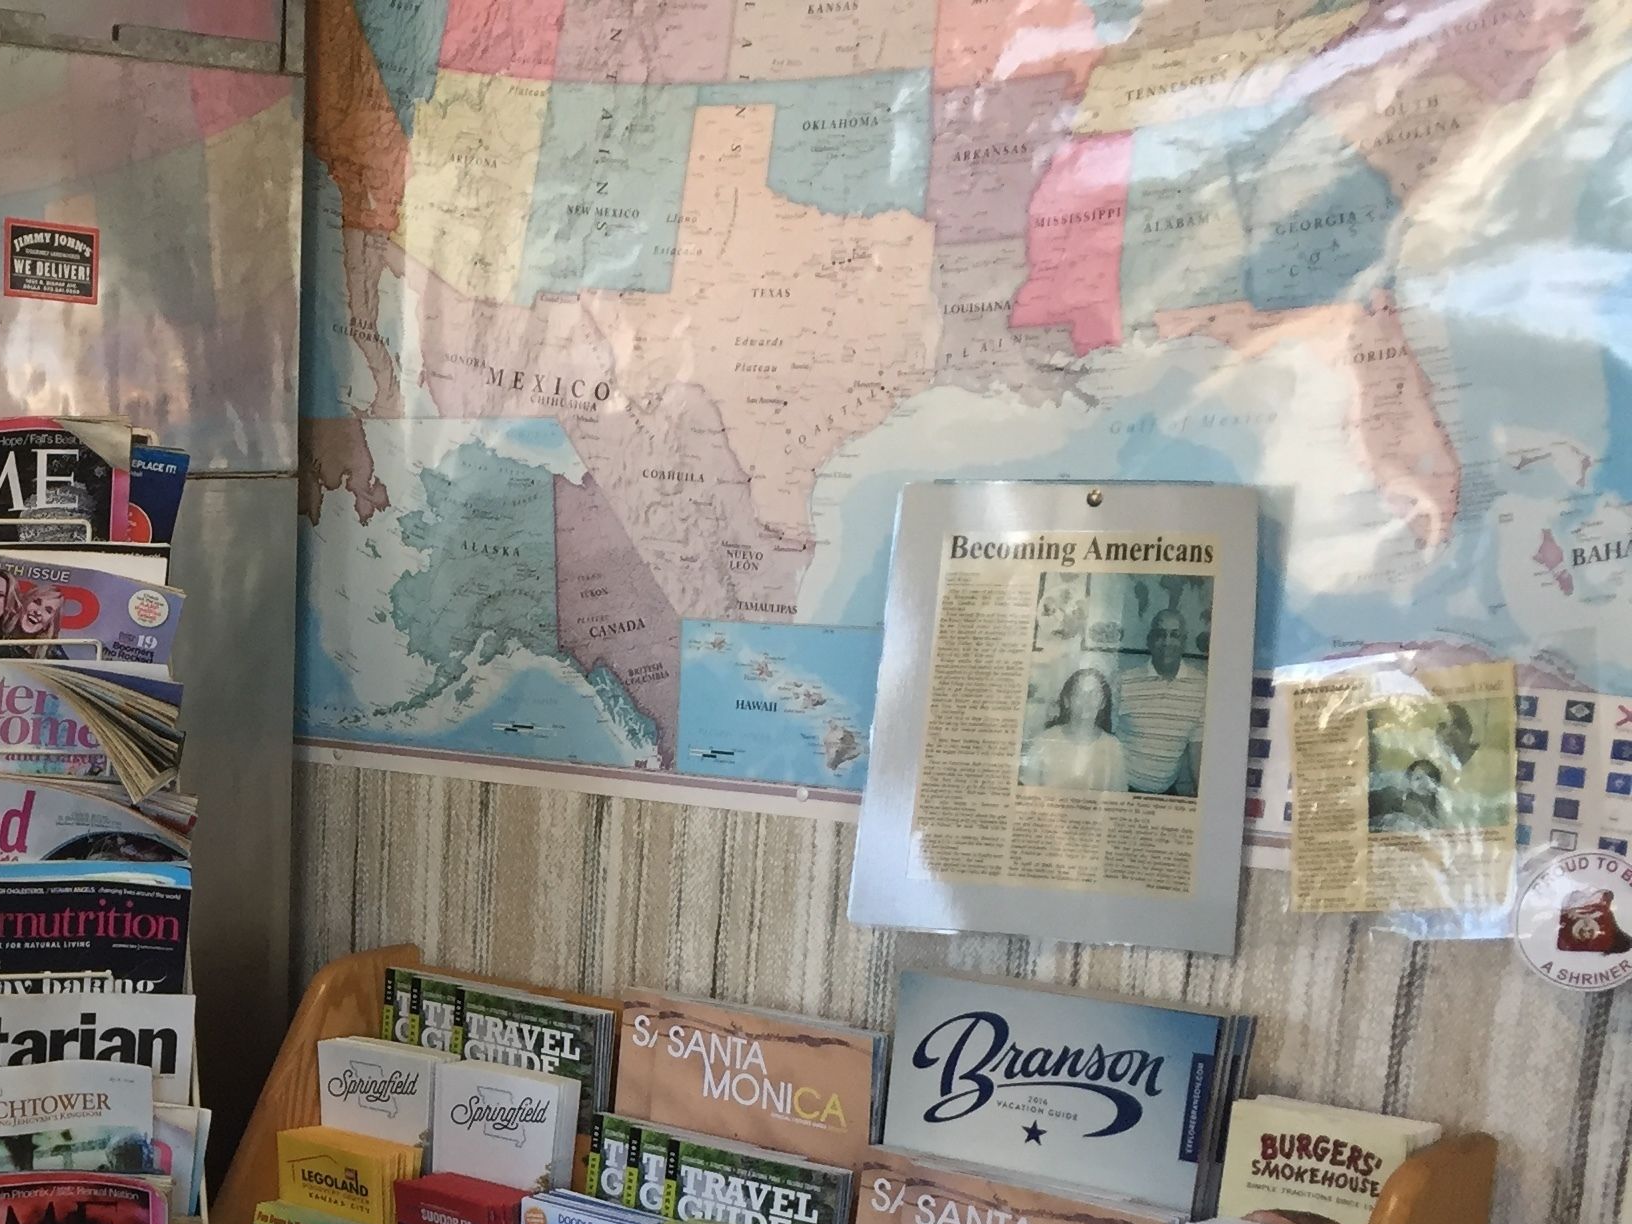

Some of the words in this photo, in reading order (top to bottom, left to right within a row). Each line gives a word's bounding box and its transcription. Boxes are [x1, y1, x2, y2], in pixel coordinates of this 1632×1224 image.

[807, 2, 859, 15] KANSAS
[801, 116, 879, 132] OKLAHOMA
[449, 154, 497, 169] ARIZONA
[952, 144, 1029, 163] ARKANSAS
[568, 205, 591, 217] NEW
[593, 205, 640, 220] MEXICO
[1034, 208, 1123, 230] MISSISSIPPI
[1275, 209, 1358, 236] GEORGIA
[13, 232, 52, 253] JIMMY
[53, 233, 92, 257] JOHN'S
[13, 258, 32, 275] WE
[36, 261, 90, 281] DELIVER!
[752, 288, 791, 299] TEXAS
[943, 300, 1011, 315] LOUISIANA
[734, 336, 784, 348] Edwards
[734, 362, 777, 373] Plateau
[485, 366, 612, 402] MEXICO
[642, 468, 705, 484] COAHUILA
[461, 541, 521, 558] ALASKA
[726, 550, 764, 562] NUEVO
[949, 535, 1077, 567] Becoming
[1083, 535, 1215, 565] Americans
[27, 567, 70, 583] ISSUE
[736, 600, 798, 615] TAMAULIPAS
[588, 617, 646, 638] CANADA
[623, 670, 670, 687] COLUMBIA
[627, 661, 663, 677] BRITISH
[735, 699, 778, 714] HAWAII
[1540, 961, 1554, 974] A
[1556, 959, 1632, 985] SHRINER
[465, 1009, 581, 1061] TRAVEL
[667, 1023, 768, 1075] SANTA
[912, 1010, 1165, 1124] Branson
[327, 1069, 420, 1103] Springfield
[702, 1059, 849, 1129] MONICA
[450, 1095, 551, 1131] Springfield
[1260, 1132, 1382, 1177] BURGERS'
[301, 1167, 369, 1197] LEGOLAND
[1251, 1158, 1381, 1198] SMOKEHOUSE
[680, 1165, 819, 1224] TRAVEL
